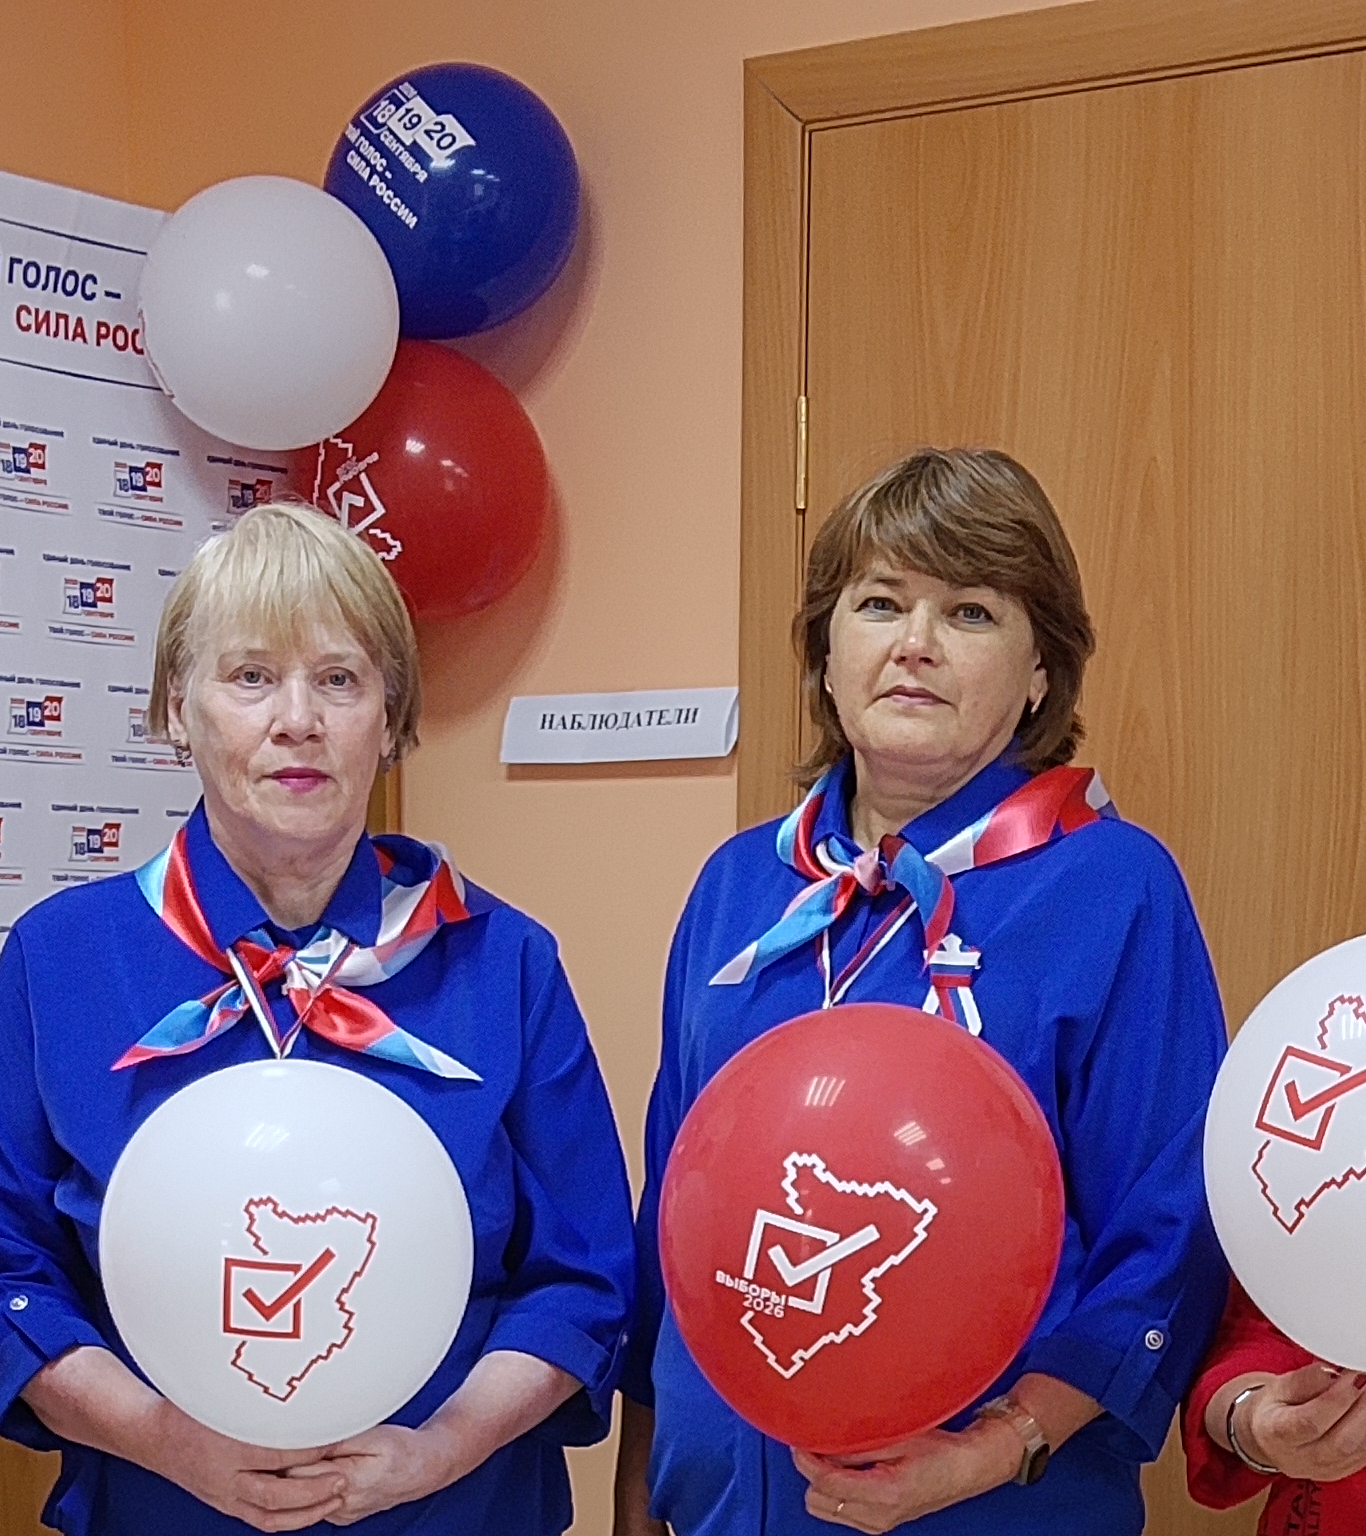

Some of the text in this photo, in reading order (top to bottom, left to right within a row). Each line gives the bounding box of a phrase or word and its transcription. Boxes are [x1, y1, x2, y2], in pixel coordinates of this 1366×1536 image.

[373, 100, 457, 150] 18 19 20
[355, 136, 387, 172] ГОЛОС
[379, 131, 428, 183] СЕНТЯБРЯ
[346, 150, 371, 182] СИЛА
[369, 174, 418, 230] РОССИИ
[8, 256, 98, 301] ГОЛОС
[16, 304, 144, 355] СИЛА РОС
[539, 707, 699, 731] НАБЛЮДАТЕЛИ
[716, 1270, 786, 1306] ВЫБОРЫ
[743, 1294, 784, 1318] 2026
